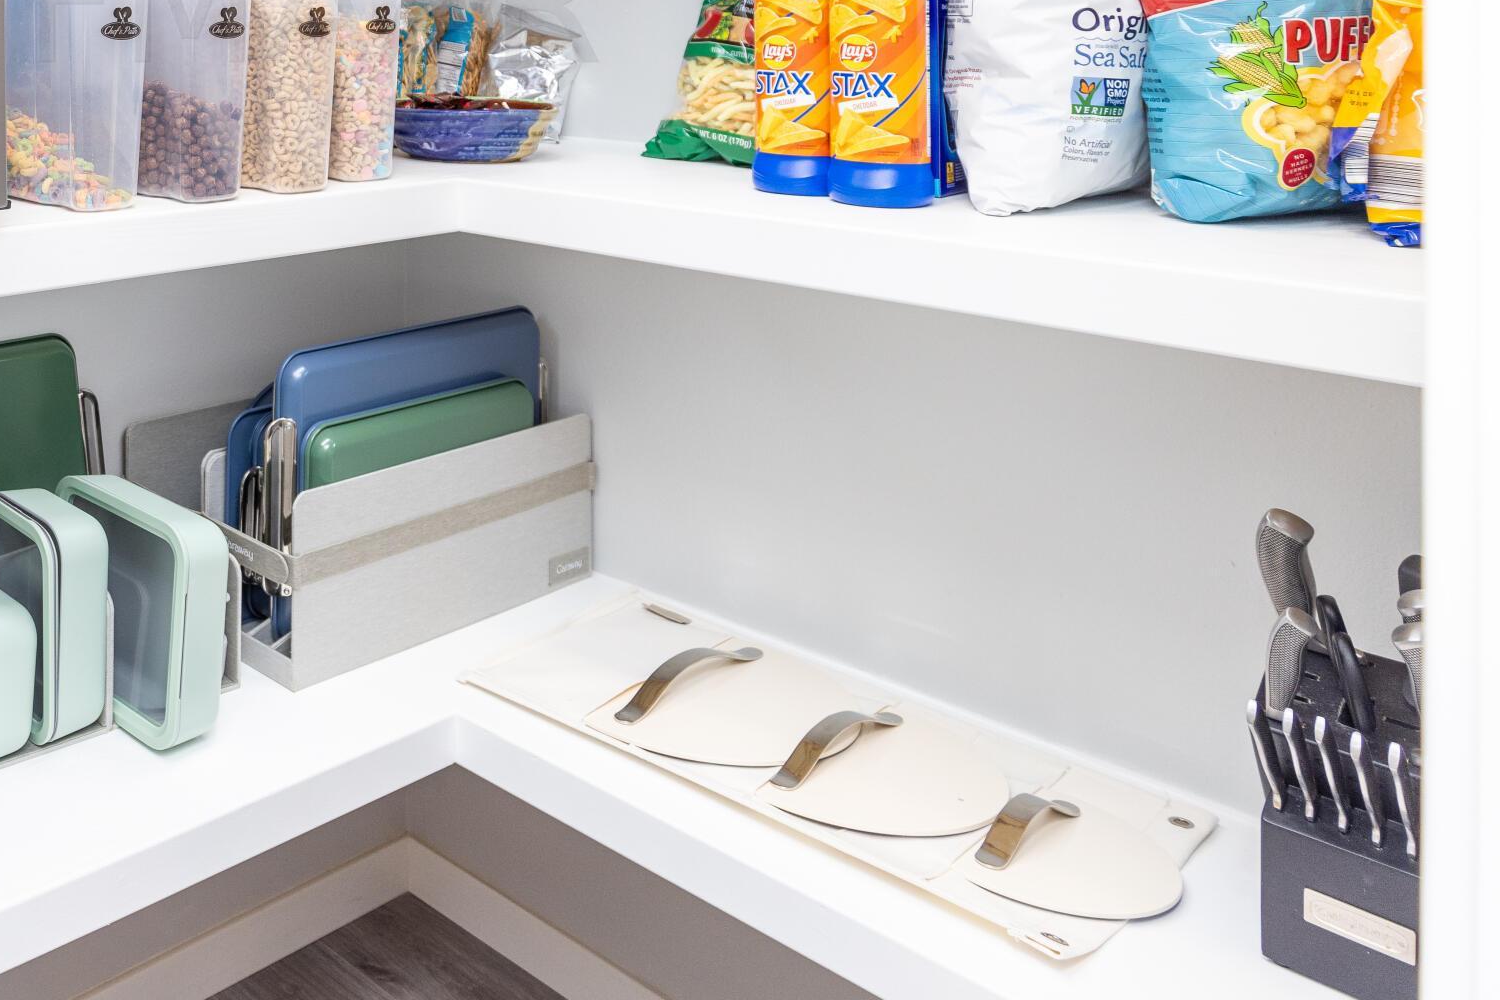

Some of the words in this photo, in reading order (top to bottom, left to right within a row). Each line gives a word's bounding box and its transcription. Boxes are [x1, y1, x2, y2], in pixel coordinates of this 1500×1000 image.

[1284, 16, 1376, 64] PUFF
[764, 42, 794, 63] Lay's
[841, 42, 875, 64] Lay's
[1074, 43, 1116, 68] Sea
[1118, 45, 1147, 69] Salt
[756, 69, 813, 96] STAX
[831, 70, 896, 99] STAX
[1106, 79, 1129, 89] NON
[1106, 88, 1129, 98] GMO
[1106, 97, 1126, 106] Project
[1074, 105, 1123, 117] VERIFIED
[717, 132, 728, 144] OZ
[728, 135, 753, 149] (170g)
[1064, 136, 1077, 146] No
[1079, 138, 1113, 149] Artificial
